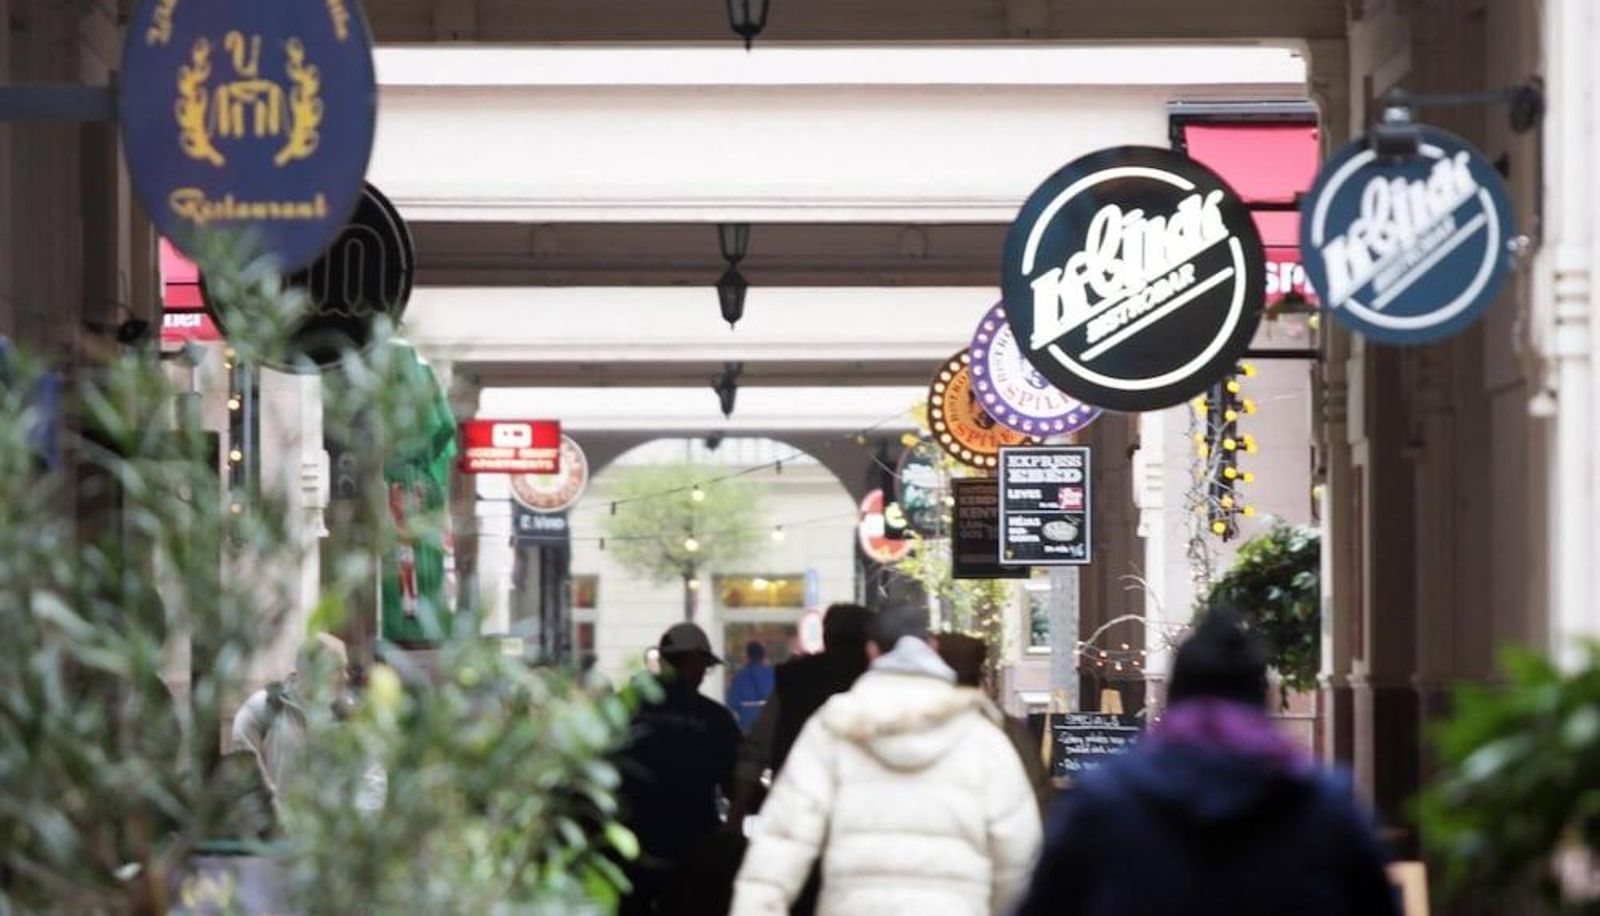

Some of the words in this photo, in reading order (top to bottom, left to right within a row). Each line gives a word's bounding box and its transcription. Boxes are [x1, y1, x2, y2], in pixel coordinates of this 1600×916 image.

[170, 188, 327, 222] Restaurant
[1086, 263, 1196, 343] BISTROBAR
[1007, 454, 1082, 467] EXPRESS
